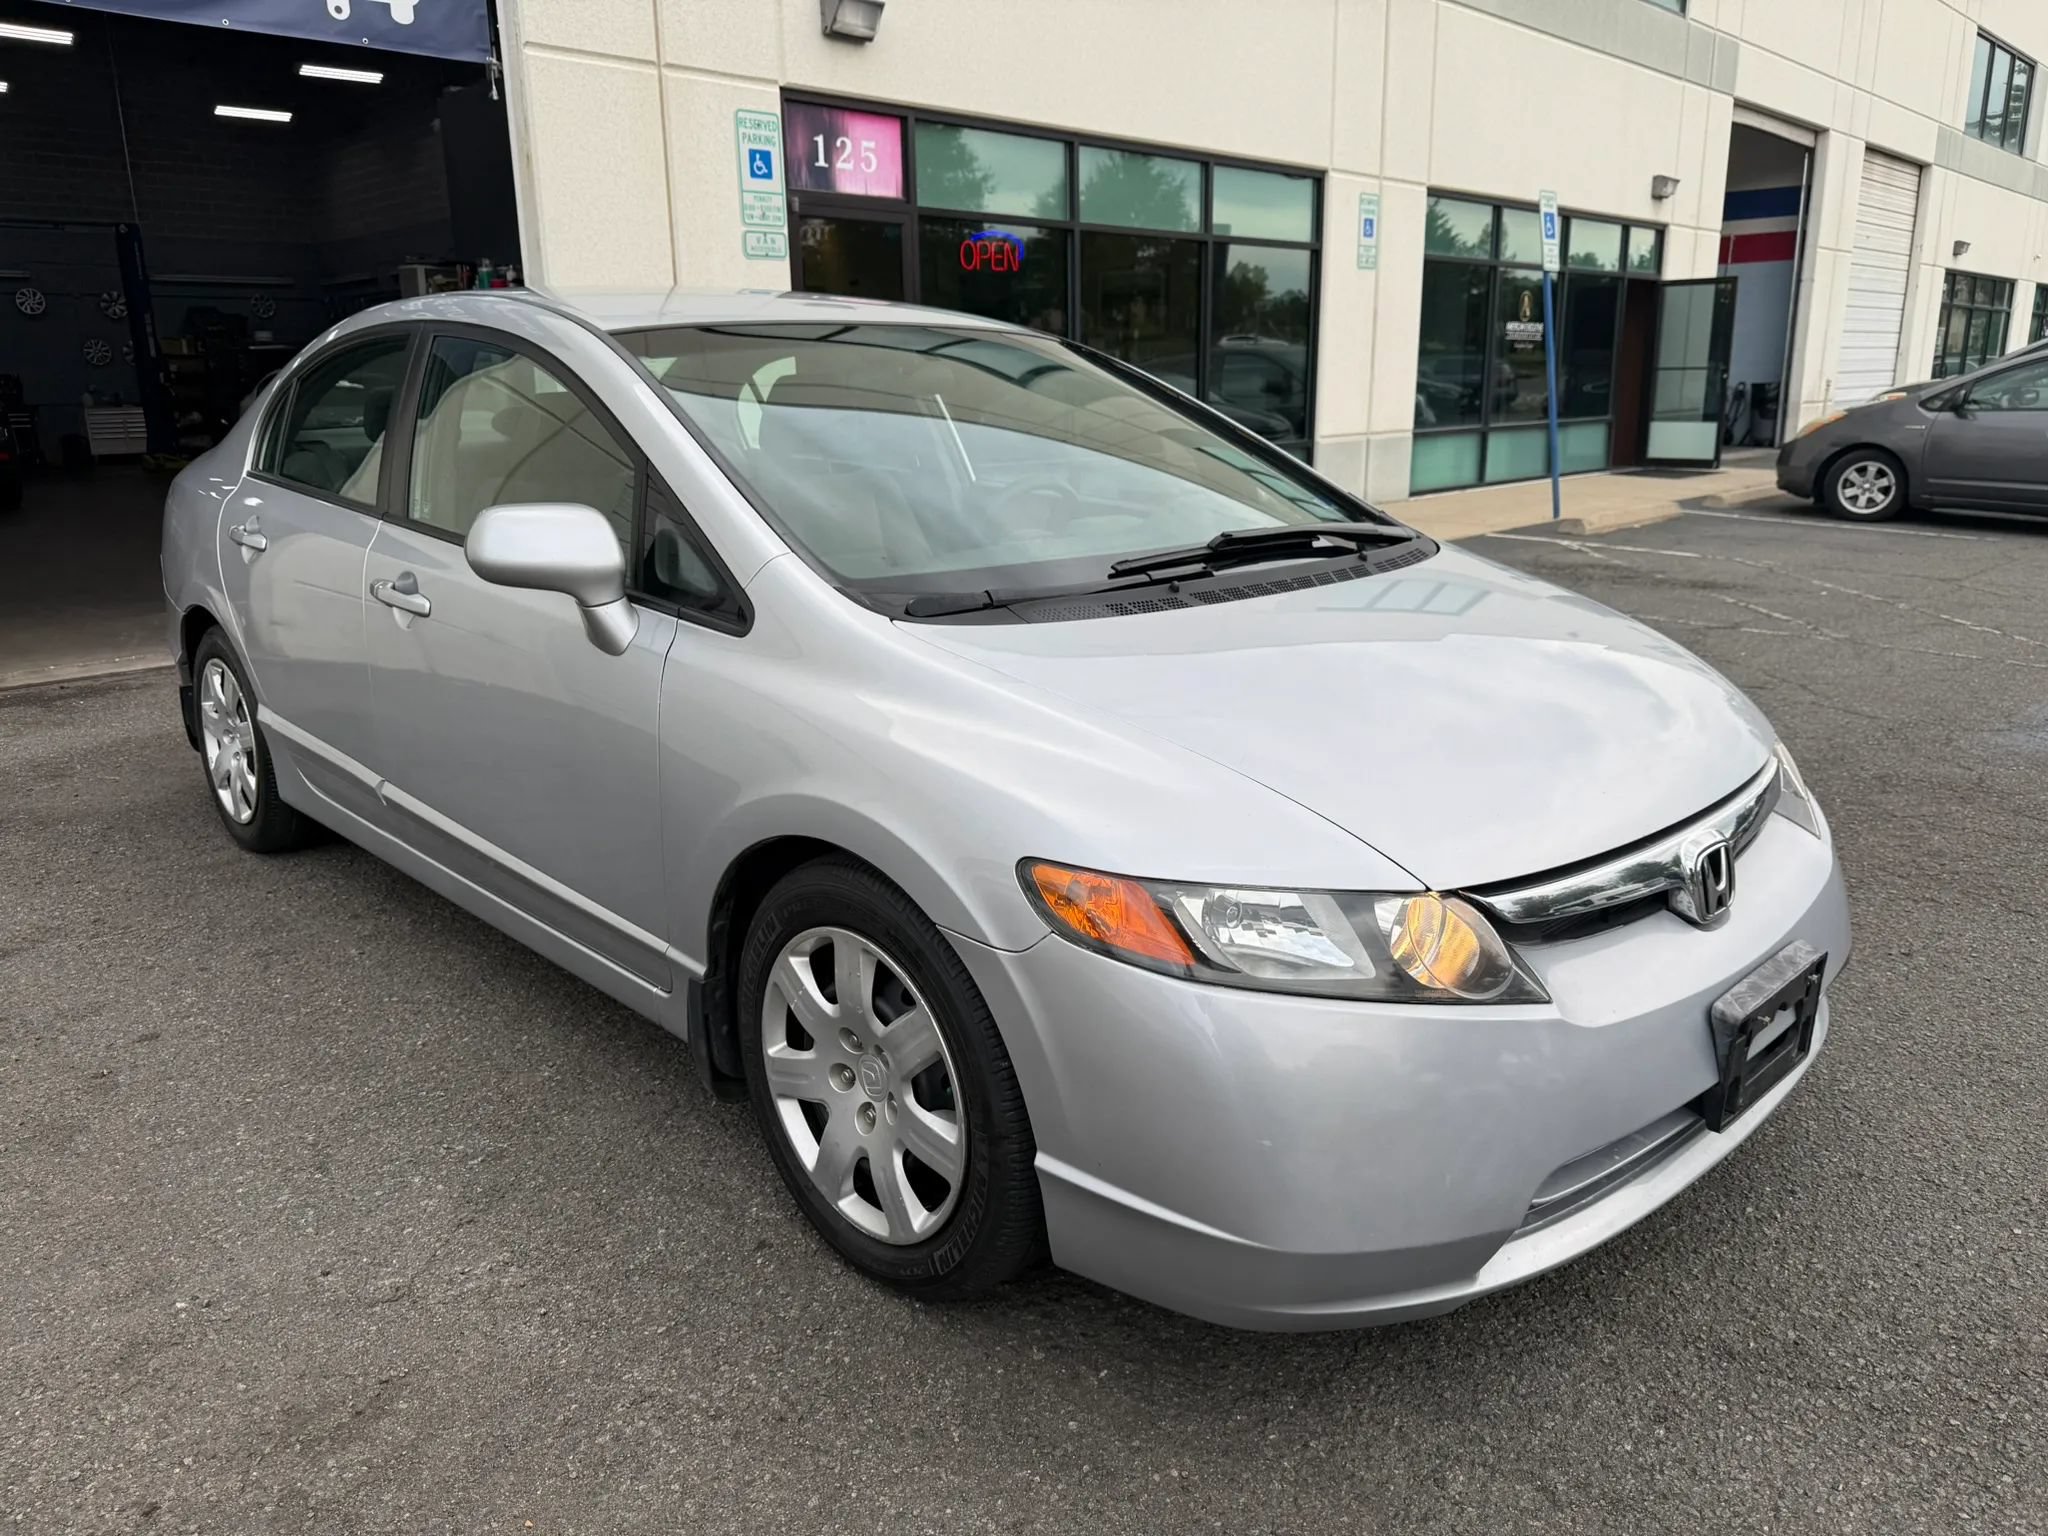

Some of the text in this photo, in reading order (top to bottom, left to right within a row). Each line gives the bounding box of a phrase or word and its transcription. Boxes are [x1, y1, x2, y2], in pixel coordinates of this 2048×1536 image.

[738, 117, 777, 132] RESERVED
[742, 132, 777, 147] PARKING
[813, 133, 878, 173] 125
[959, 239, 1021, 272] OPEN
